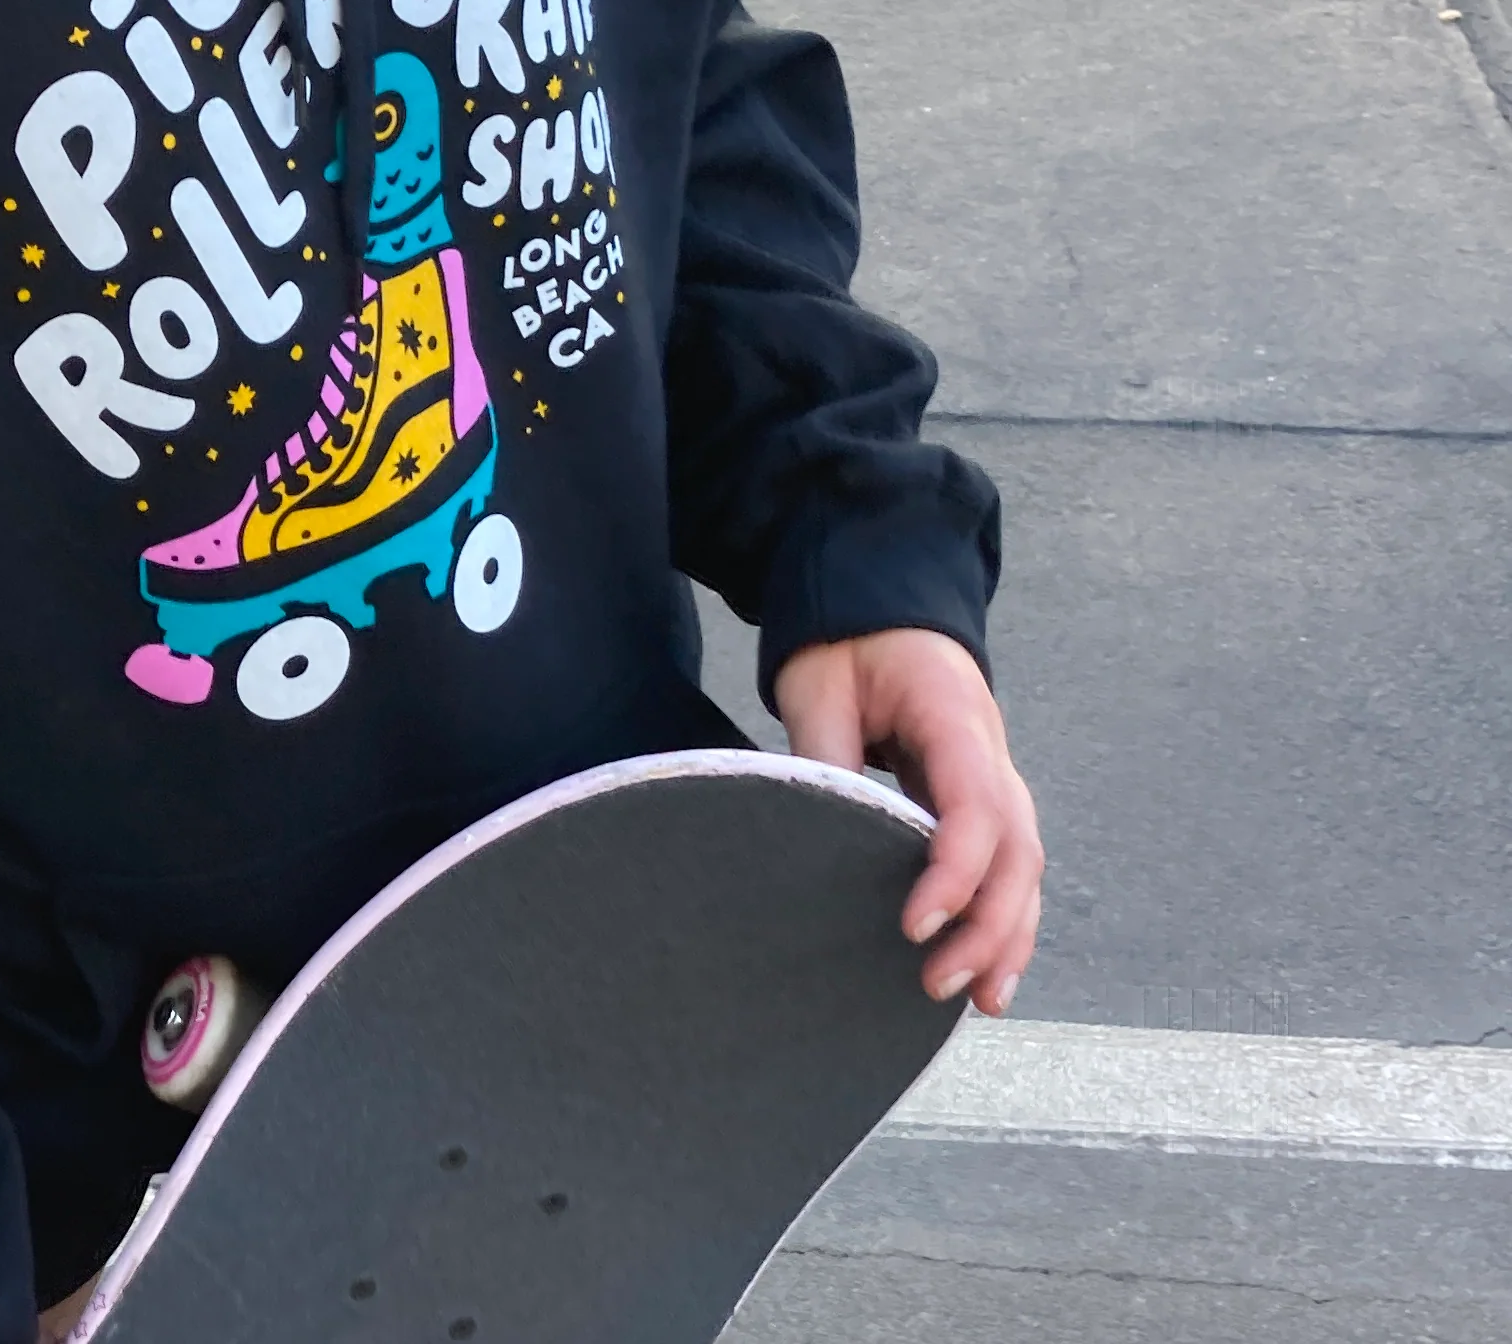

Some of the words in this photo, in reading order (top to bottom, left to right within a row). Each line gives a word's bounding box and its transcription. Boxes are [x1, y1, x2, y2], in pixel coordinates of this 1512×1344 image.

[462, 86, 616, 211] SHO
[503, 208, 607, 290] LONG
[511, 234, 624, 339] BEACH
[548, 307, 615, 368] CA
